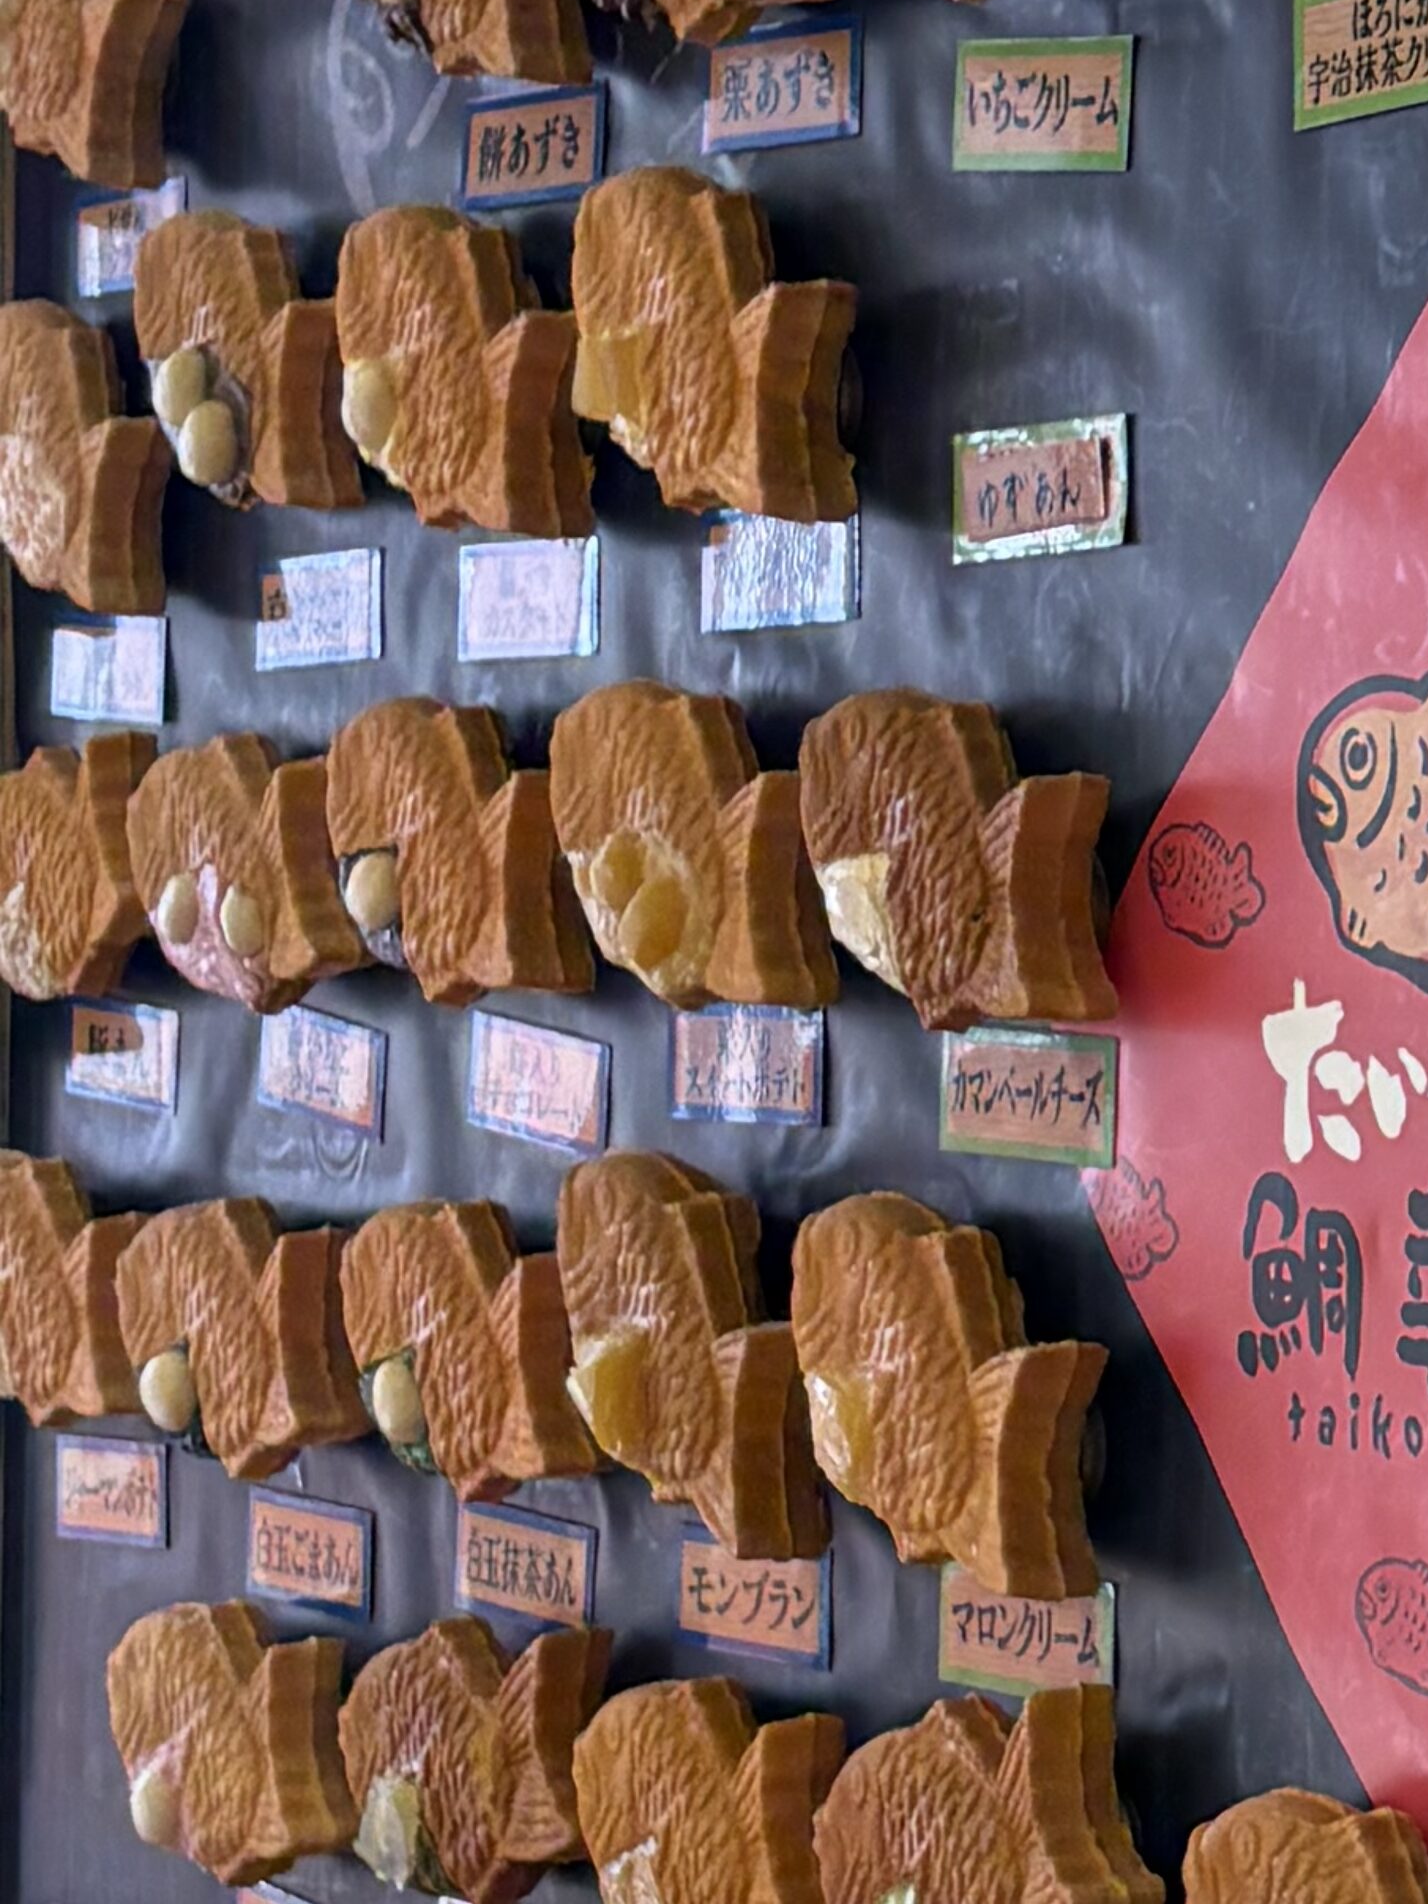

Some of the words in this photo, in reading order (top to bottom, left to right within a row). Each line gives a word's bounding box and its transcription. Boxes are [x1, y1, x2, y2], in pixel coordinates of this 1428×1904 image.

[968, 70, 1119, 135] いちごクリーム
[688, 1566, 816, 1630] モンブラン
[952, 1602, 1099, 1667] マロンクリーム
